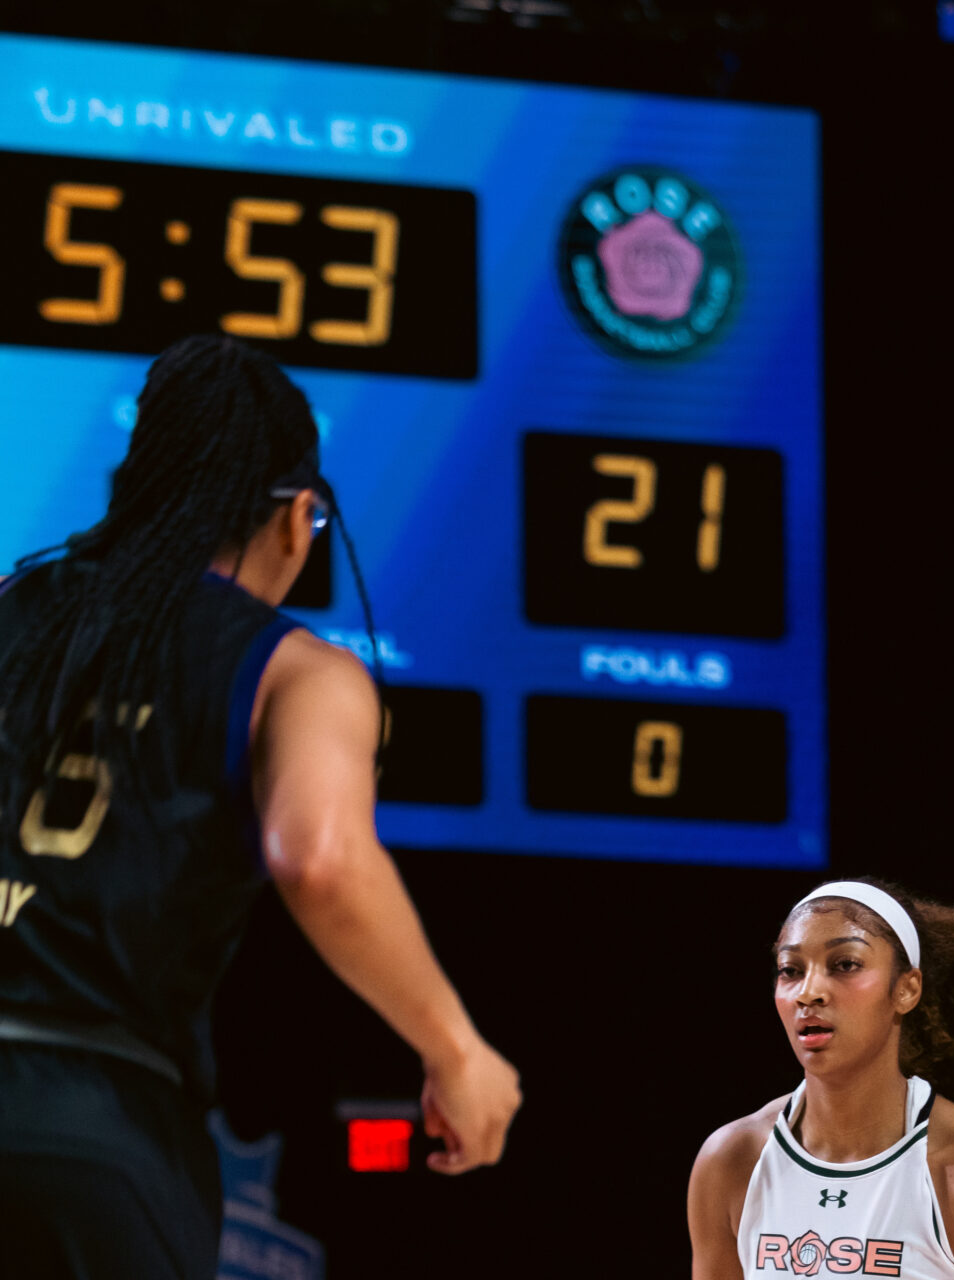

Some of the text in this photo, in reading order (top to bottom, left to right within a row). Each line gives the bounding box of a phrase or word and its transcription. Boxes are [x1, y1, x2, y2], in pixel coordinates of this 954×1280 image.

[33, 84, 413, 156] UNRIVALED
[582, 173, 722, 241] ROSE
[38, 183, 399, 347] 5:53
[583, 454, 726, 573] 21
[580, 645, 733, 690] FOULS
[631, 720, 683, 798] 0
[756, 1229, 904, 1278] ROSE
